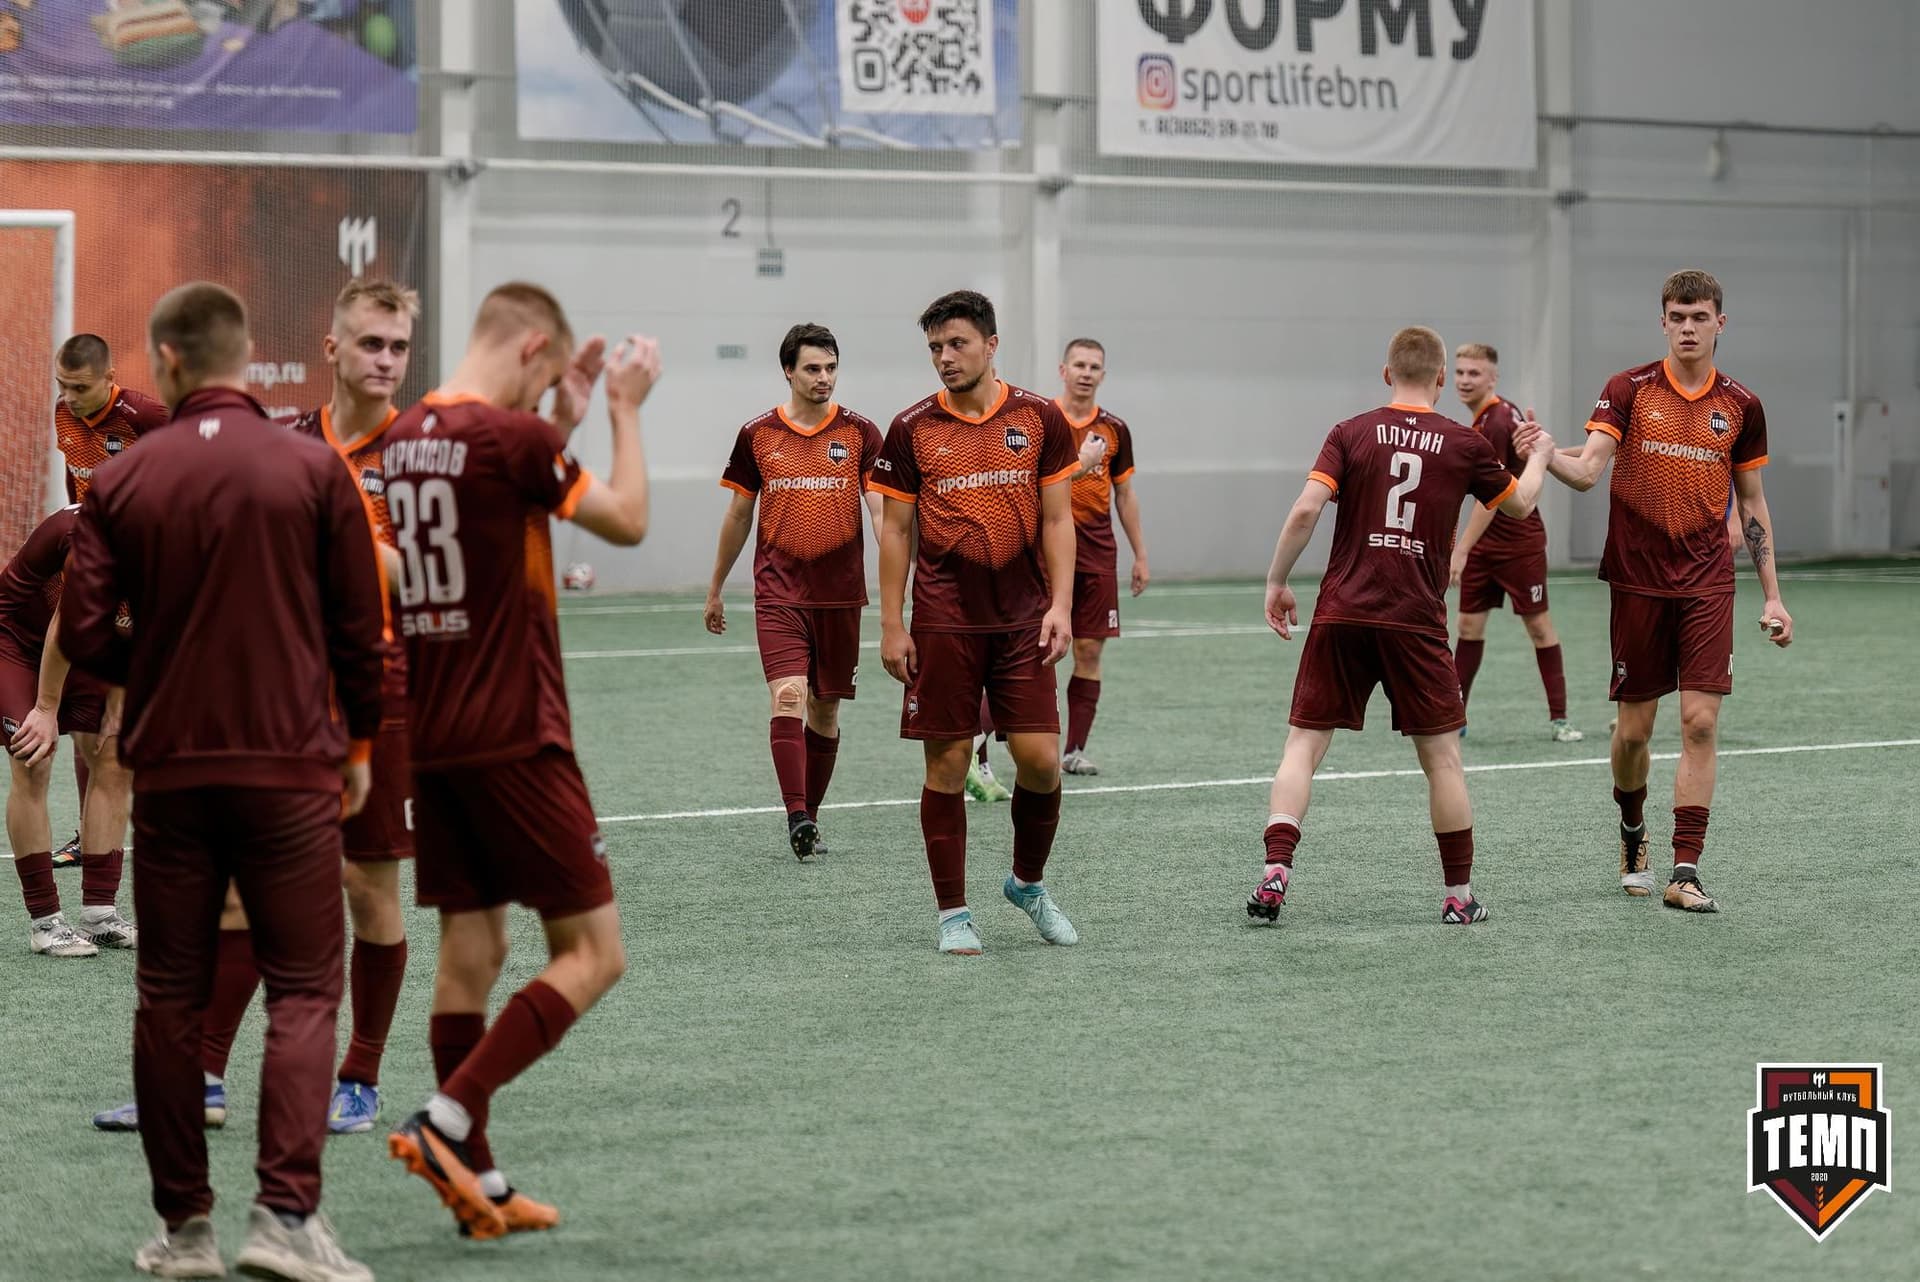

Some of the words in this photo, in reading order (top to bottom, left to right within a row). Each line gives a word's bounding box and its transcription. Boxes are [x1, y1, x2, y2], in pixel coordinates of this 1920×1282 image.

[1182, 63, 1399, 111] sportlifebrn
[721, 198, 741, 238] 2
[1376, 424, 1444, 454] ПЛУГИН
[769, 476, 848, 493] ПРОДИНВЕСТ
[937, 469, 1031, 495] ПРОДИНВЕСТ
[1385, 451, 1423, 533] 2
[386, 478, 466, 608] 33
